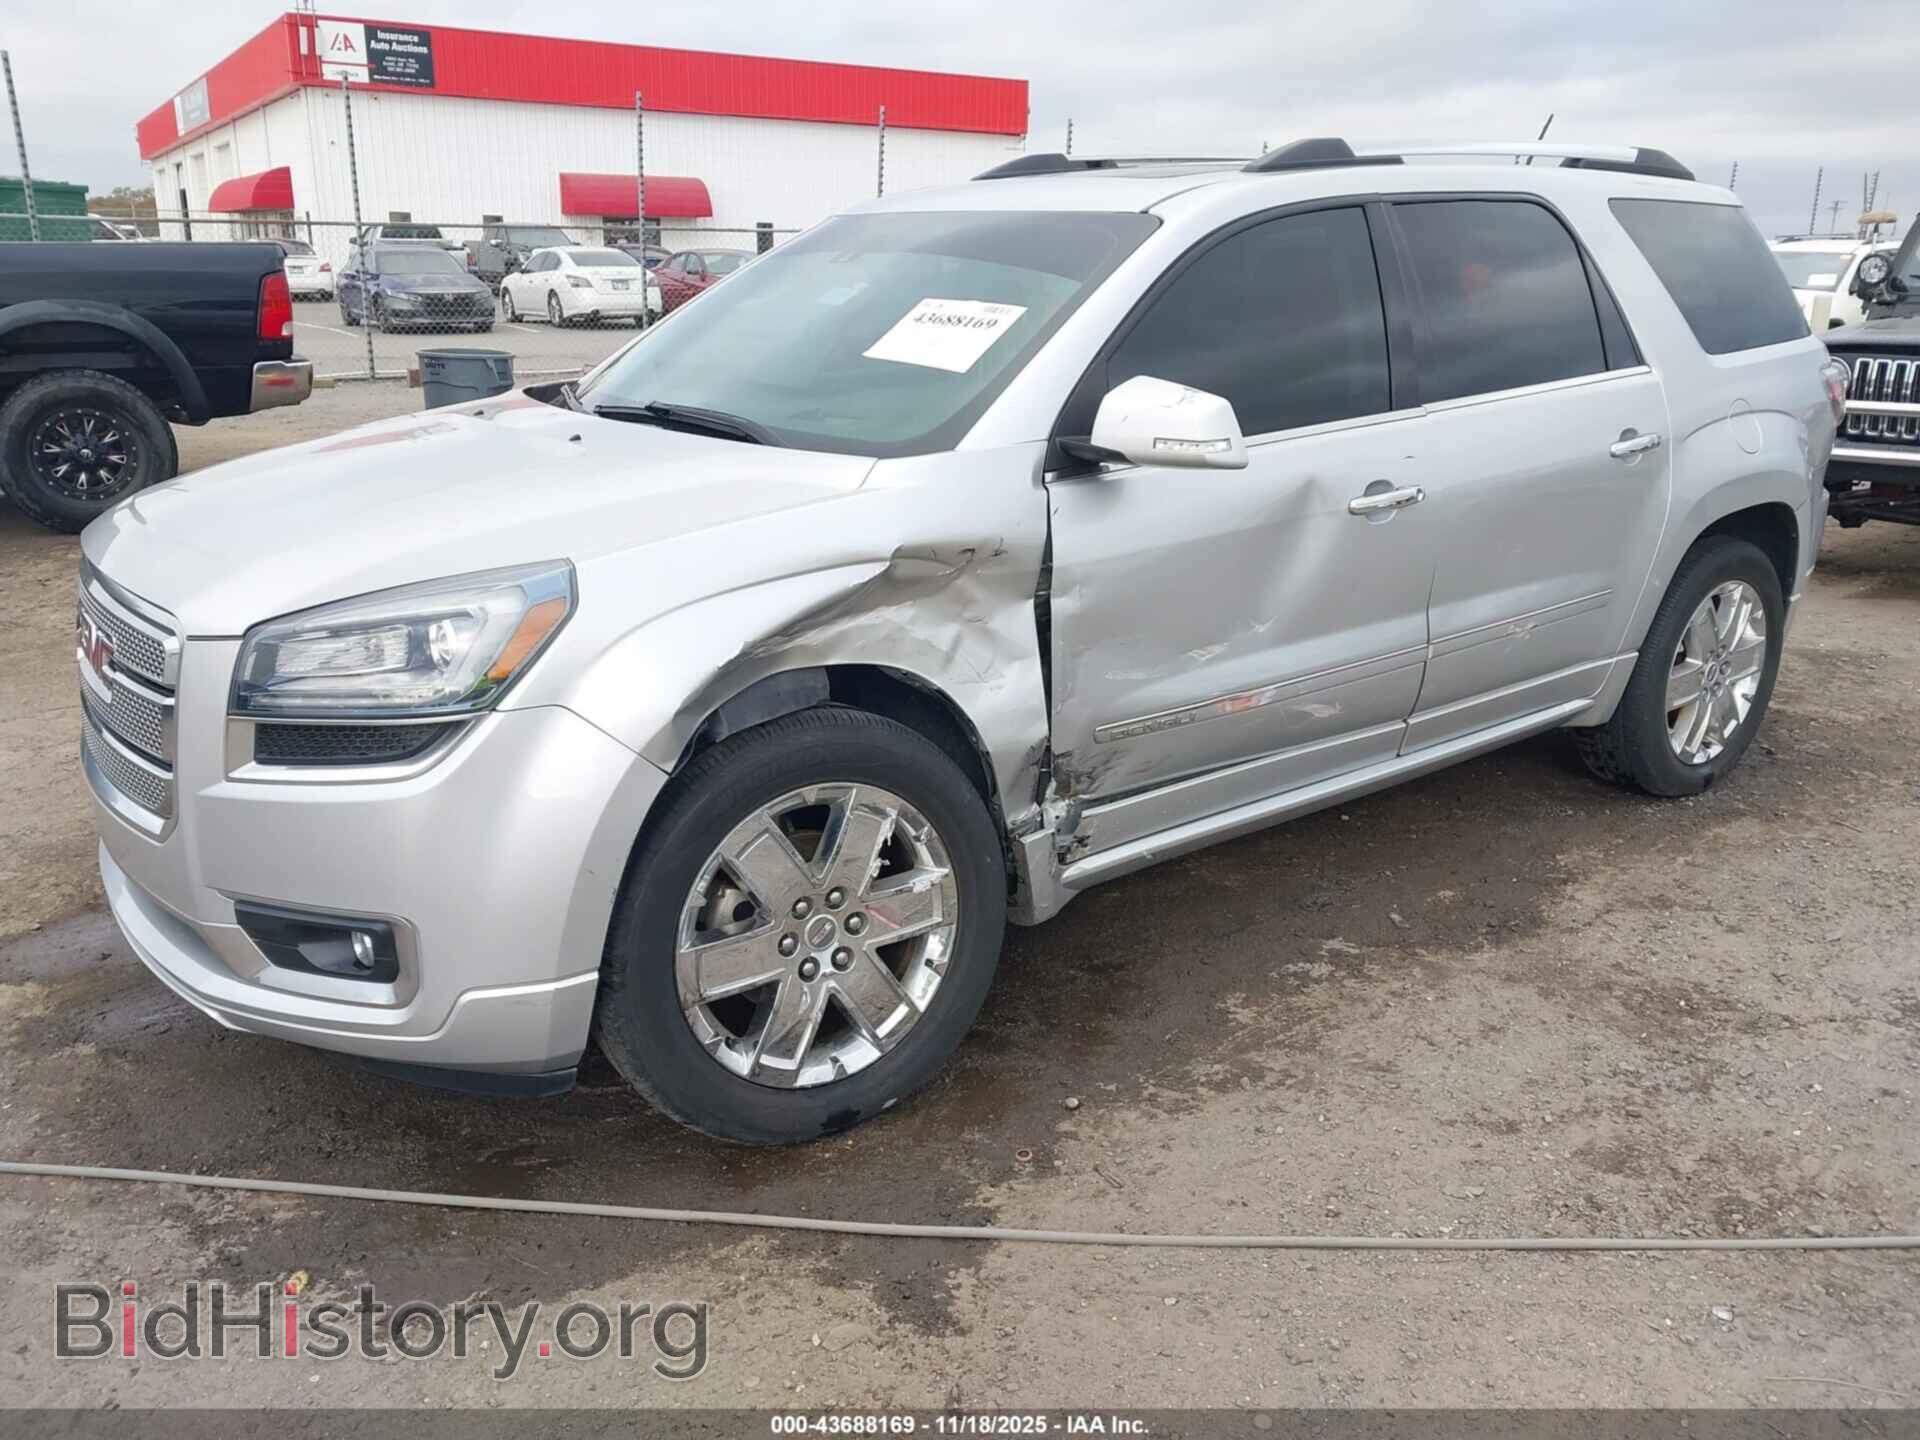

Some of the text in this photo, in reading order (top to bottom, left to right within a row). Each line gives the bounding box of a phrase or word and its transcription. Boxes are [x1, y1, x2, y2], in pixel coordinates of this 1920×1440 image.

[377, 29, 420, 42] Insurance
[370, 39, 428, 54] Auto Auctions
